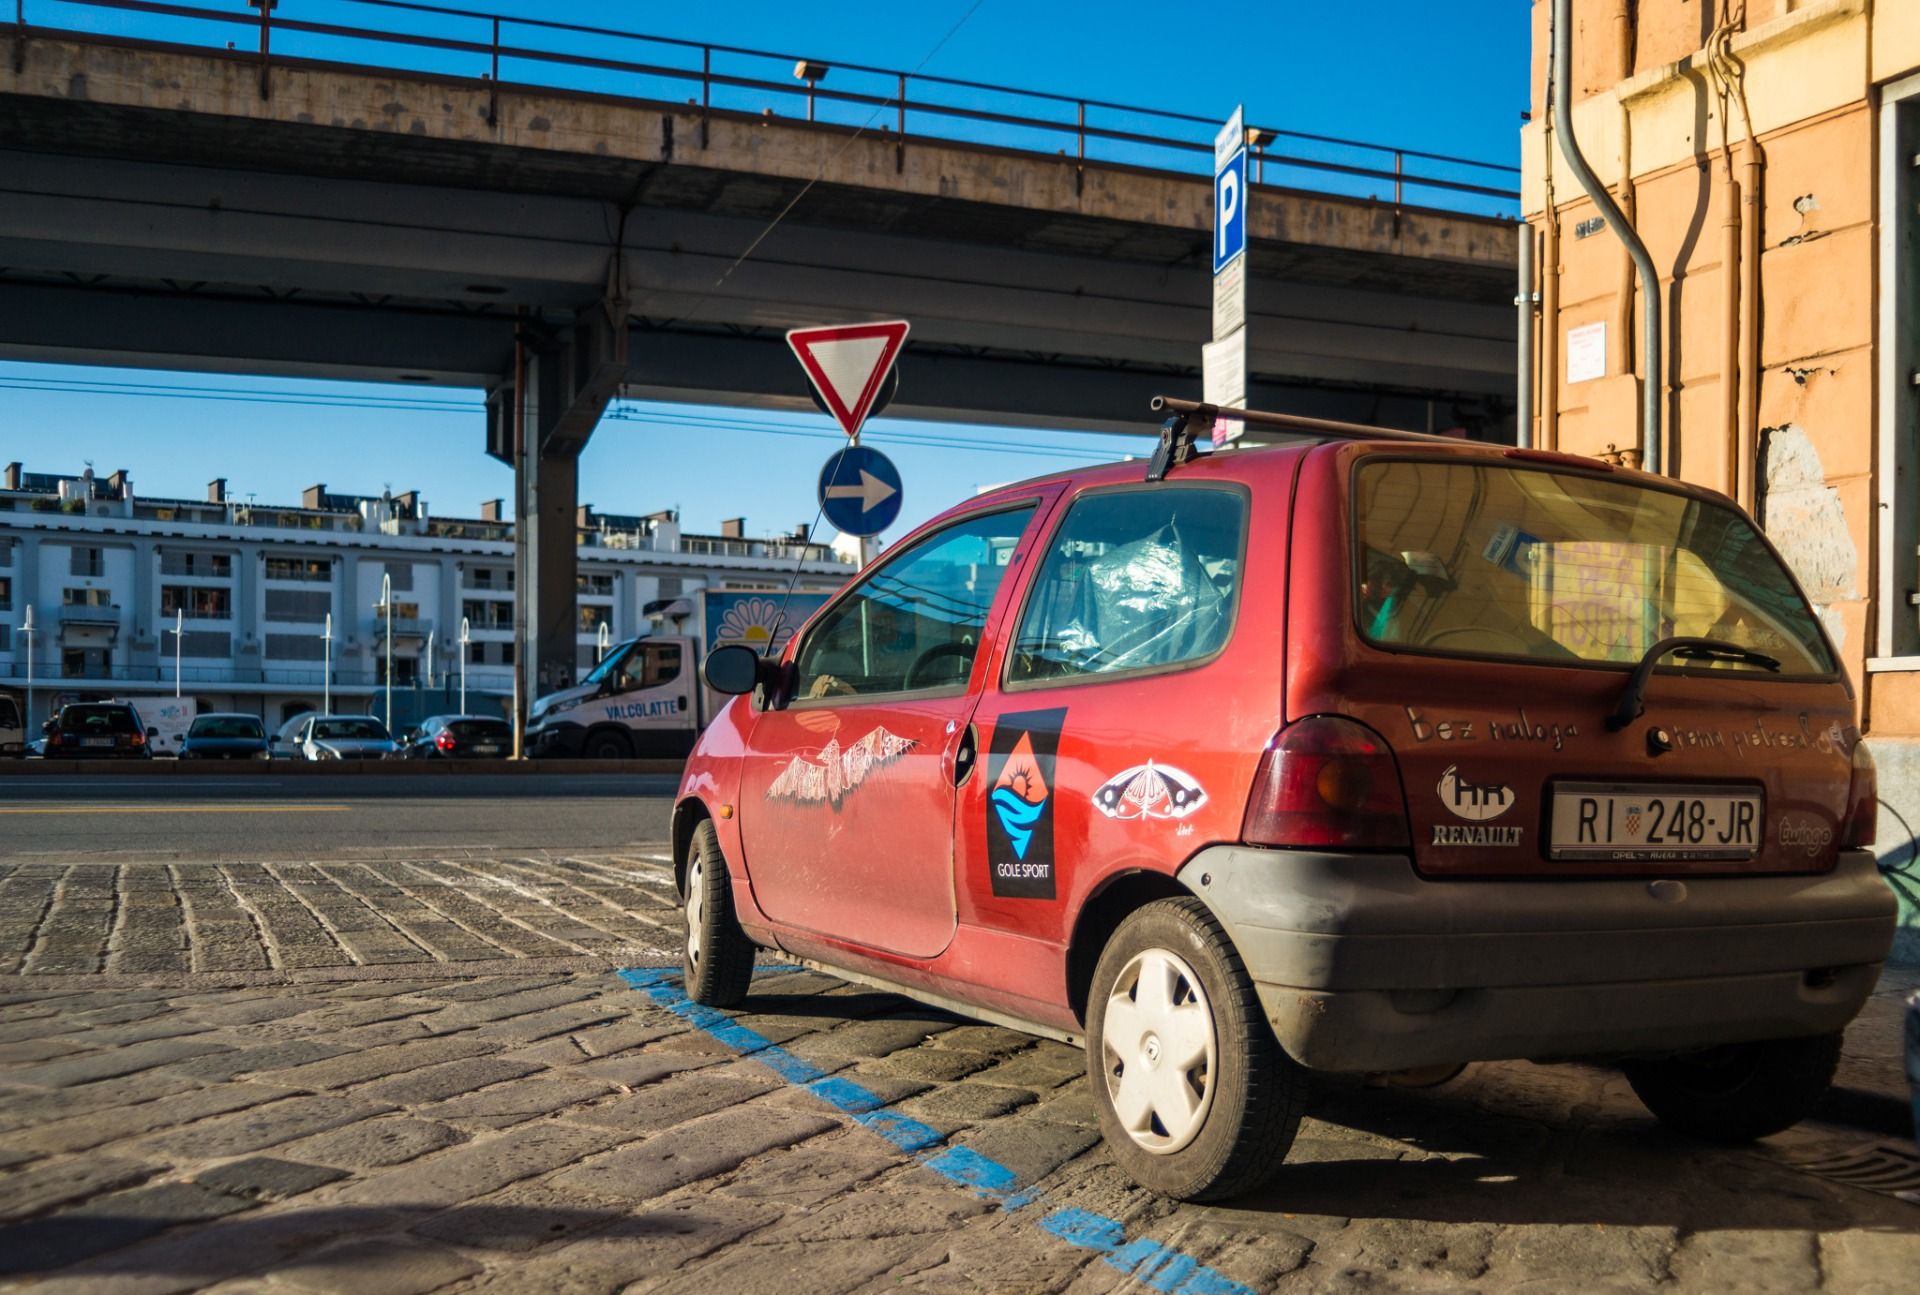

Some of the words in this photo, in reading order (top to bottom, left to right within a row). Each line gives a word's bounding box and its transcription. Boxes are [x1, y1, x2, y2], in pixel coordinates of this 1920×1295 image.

[1219, 169, 1238, 259] P
[605, 699, 677, 720] VALCOLATTE
[1577, 798, 1614, 843] RI
[1646, 798, 1754, 844] 248-JR
[1432, 825, 1524, 847] RENAULT
[997, 863, 1021, 878] GOLE
[1021, 863, 1049, 879] SPORT
